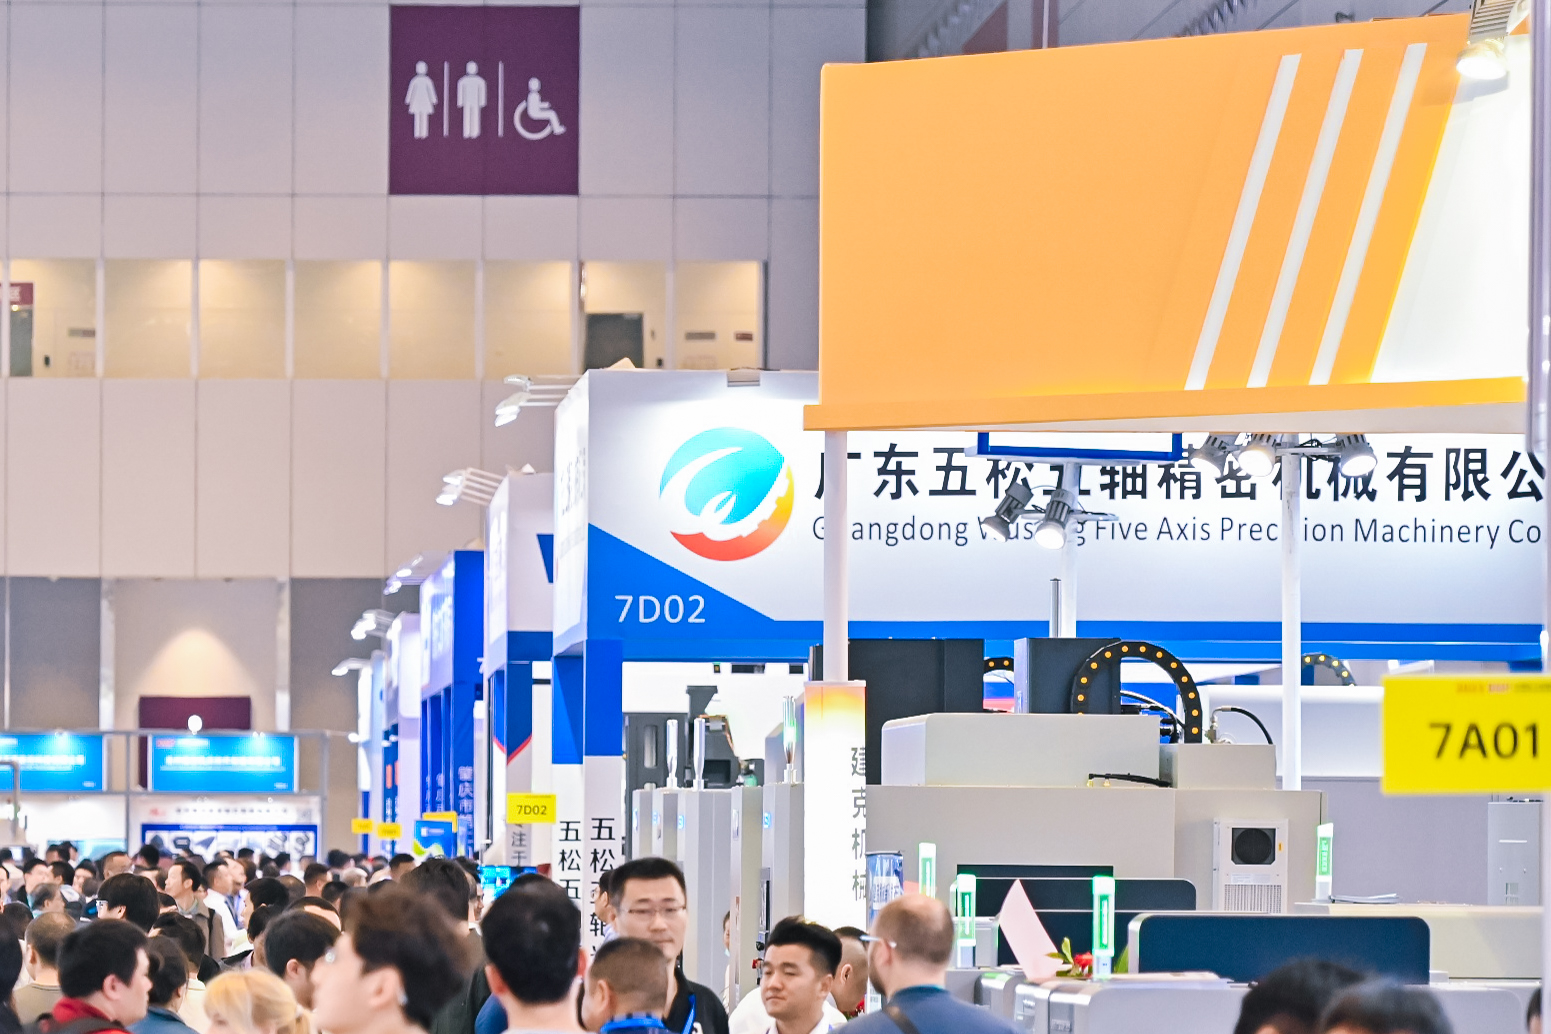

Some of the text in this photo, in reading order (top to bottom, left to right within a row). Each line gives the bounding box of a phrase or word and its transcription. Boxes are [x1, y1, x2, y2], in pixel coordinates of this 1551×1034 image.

[1096, 517, 1148, 541] Five
[1157, 516, 1210, 541] Axis
[1220, 517, 1343, 543] Precion
[1354, 517, 1499, 549] Machinery
[1509, 519, 1541, 544] Co
[615, 594, 705, 624] 7D02
[1428, 722, 1539, 760] 7A01
[516, 805, 547, 816] 7D02
[511, 824, 527, 867] 注于
[559, 820, 581, 900] 五松五
